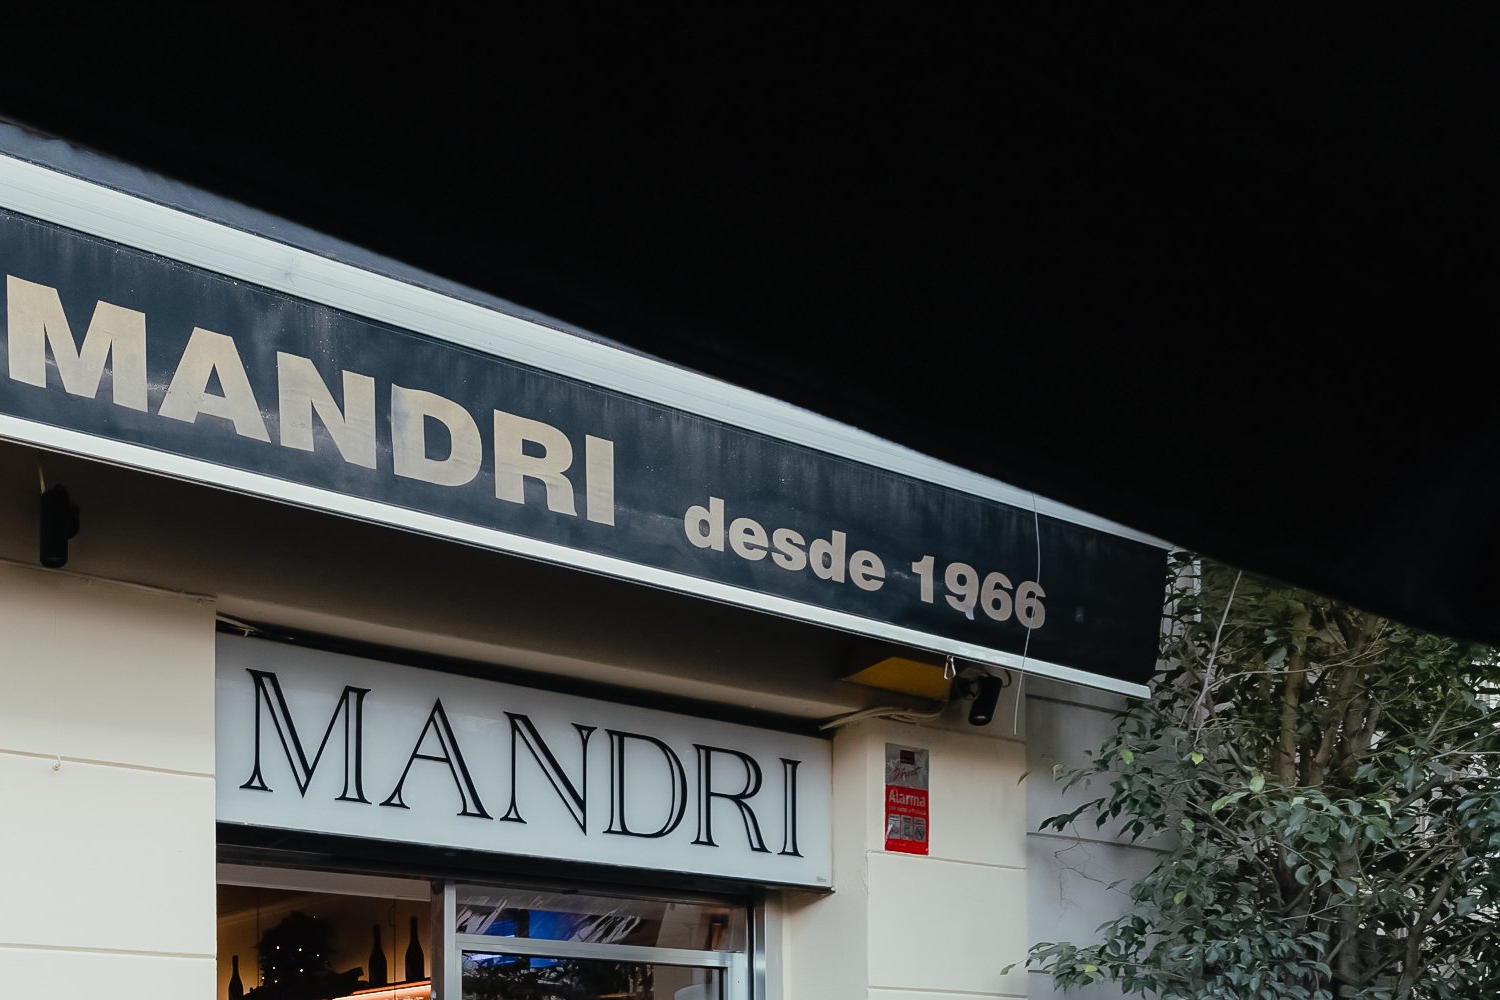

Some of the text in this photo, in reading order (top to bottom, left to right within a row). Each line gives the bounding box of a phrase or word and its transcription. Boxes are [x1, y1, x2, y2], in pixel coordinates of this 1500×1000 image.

[7, 274, 616, 527] MANDRI
[684, 496, 1046, 630] desde 1966
[239, 668, 804, 858] MANDRI
[889, 788, 926, 807] Alarma
